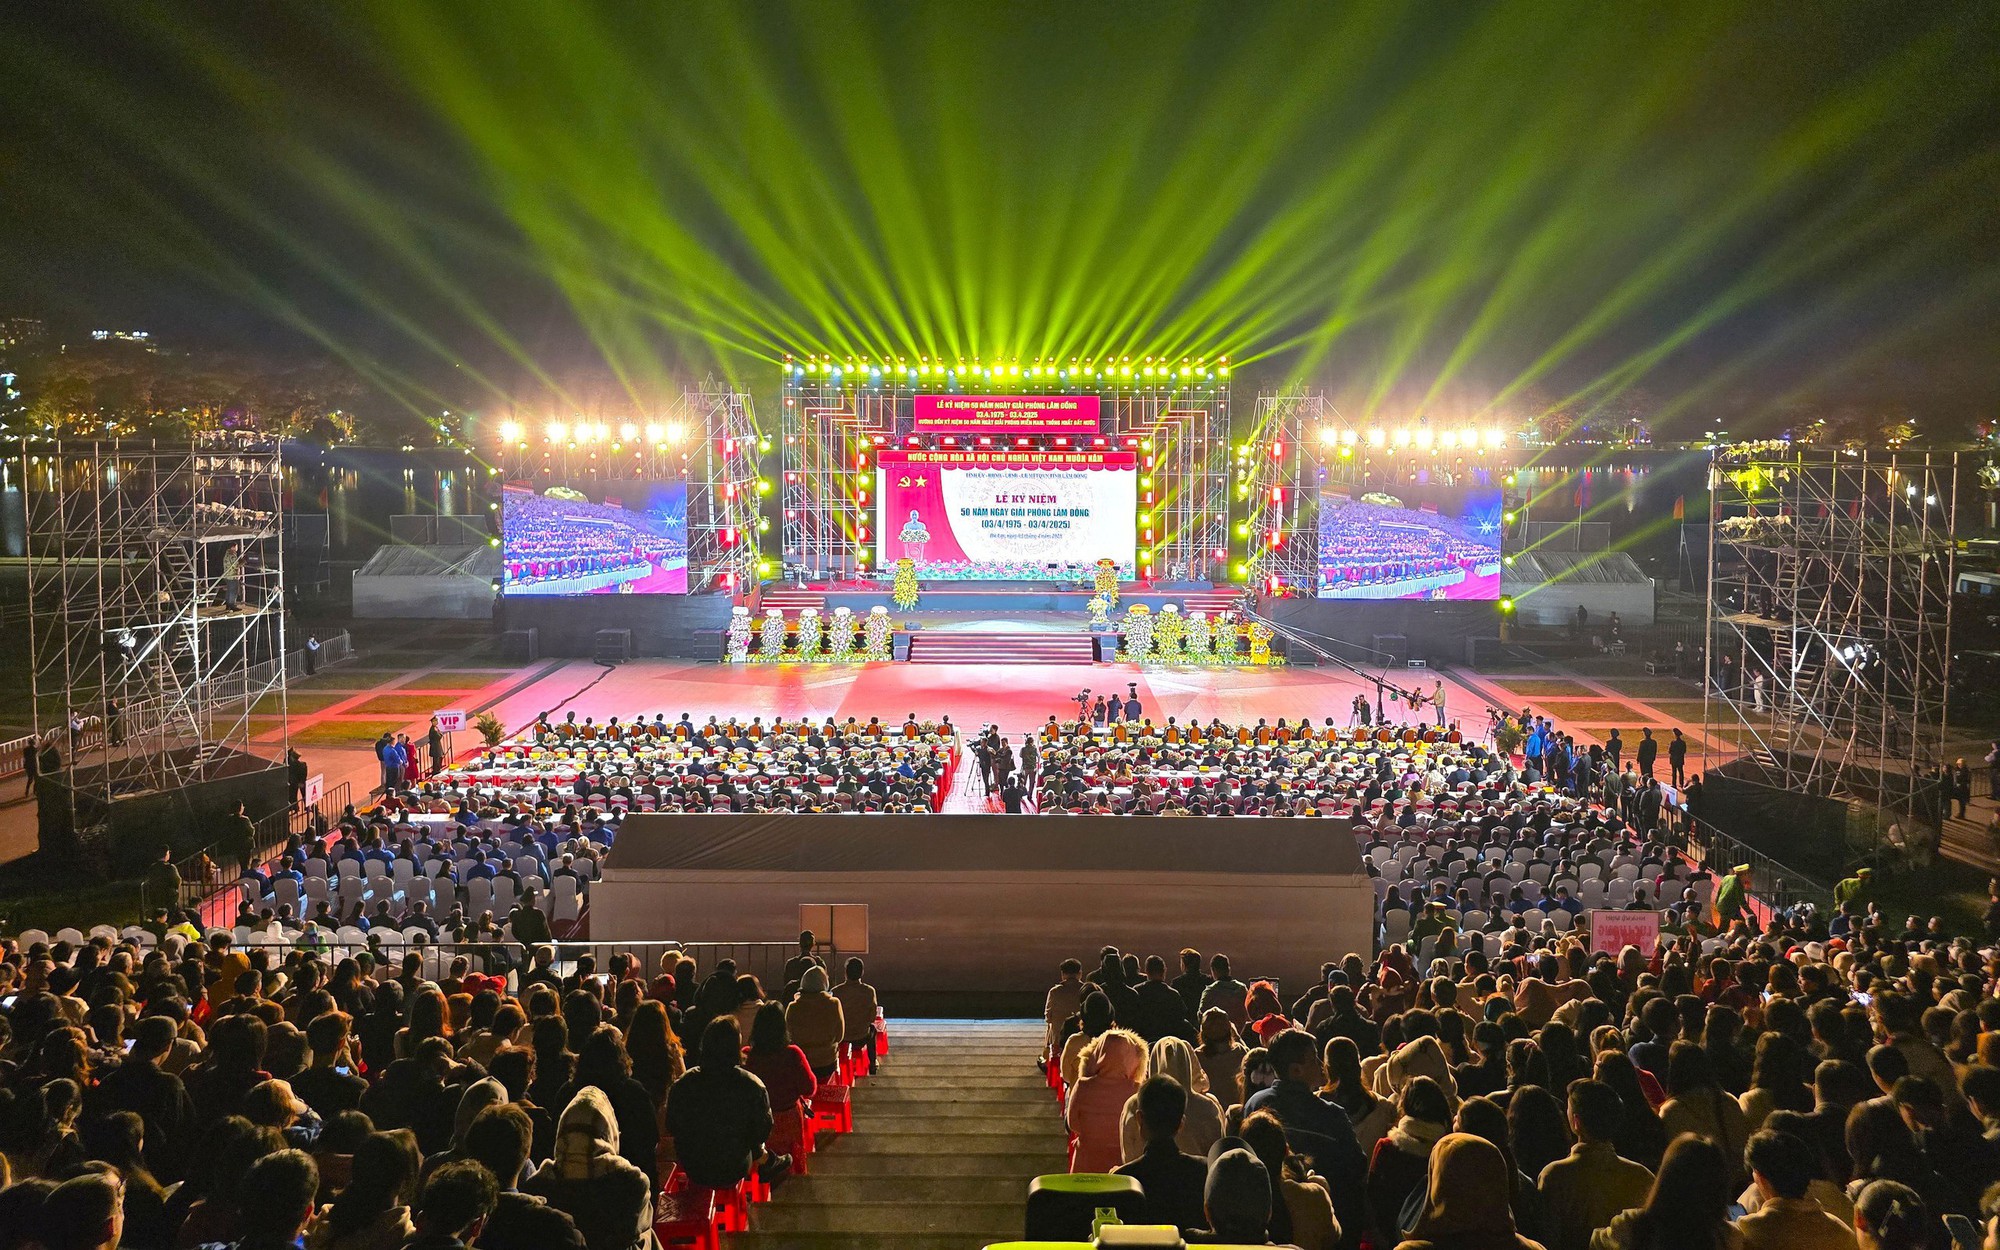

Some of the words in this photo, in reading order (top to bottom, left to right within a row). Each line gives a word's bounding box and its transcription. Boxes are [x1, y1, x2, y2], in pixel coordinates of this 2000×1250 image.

[936, 400, 944, 409] LỄ
[954, 401, 970, 410] NIỆM
[980, 400, 994, 409] NĂM
[994, 400, 1010, 409] NGÀY
[1012, 400, 1024, 409] GIẢI
[1024, 400, 1046, 409] PHÓNG
[1046, 400, 1060, 409] LÂM
[1060, 400, 1077, 409] ĐỒNG
[908, 453, 927, 462] NƯỚC
[928, 453, 948, 462] CỘNG
[966, 453, 975, 462] XÃ
[977, 453, 989, 462] HỘI
[991, 453, 1006, 462] CHỦ
[1008, 453, 1030, 462] NGHĨA
[1031, 454, 1046, 463] VIỆT
[1048, 454, 1064, 462] NAM
[1066, 454, 1086, 462] MUÔN
[1088, 454, 1103, 462] NĂM
[996, 492, 1008, 503] LỄ
[1029, 493, 1056, 505] NIỆM
[960, 508, 970, 516] 50
[972, 507, 988, 516] NĂM
[990, 507, 1008, 516] NGÀY
[1010, 506, 1025, 516] GIẢI
[1027, 507, 1052, 516] PHÓNG
[1053, 507, 1068, 516] LÂM
[1070, 506, 1090, 516] ĐỒNG
[440, 716, 459, 726] VIP
